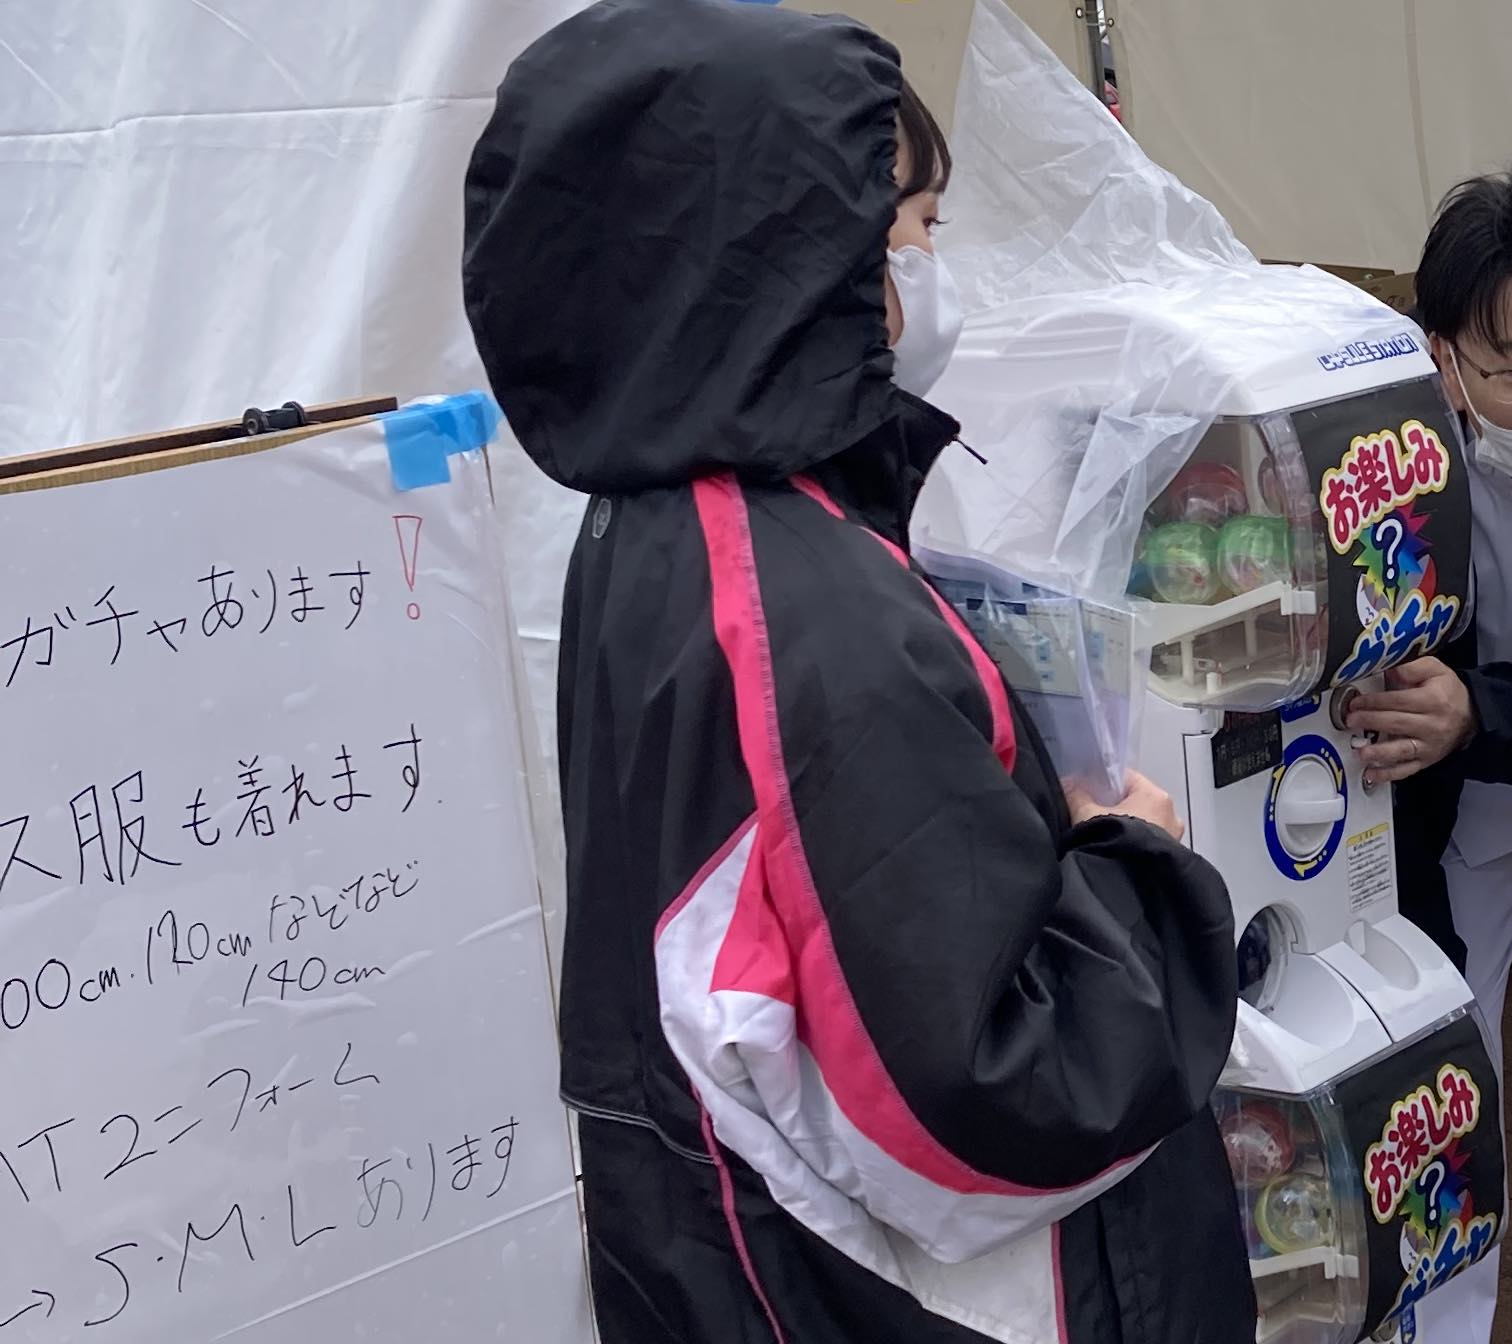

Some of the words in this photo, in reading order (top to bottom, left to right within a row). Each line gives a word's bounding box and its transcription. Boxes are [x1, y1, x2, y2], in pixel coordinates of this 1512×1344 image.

[1324, 426, 1445, 548] お楽しみ
[1336, 596, 1456, 683] ガチャ
[1368, 1071, 1475, 1216] お楽しみ
